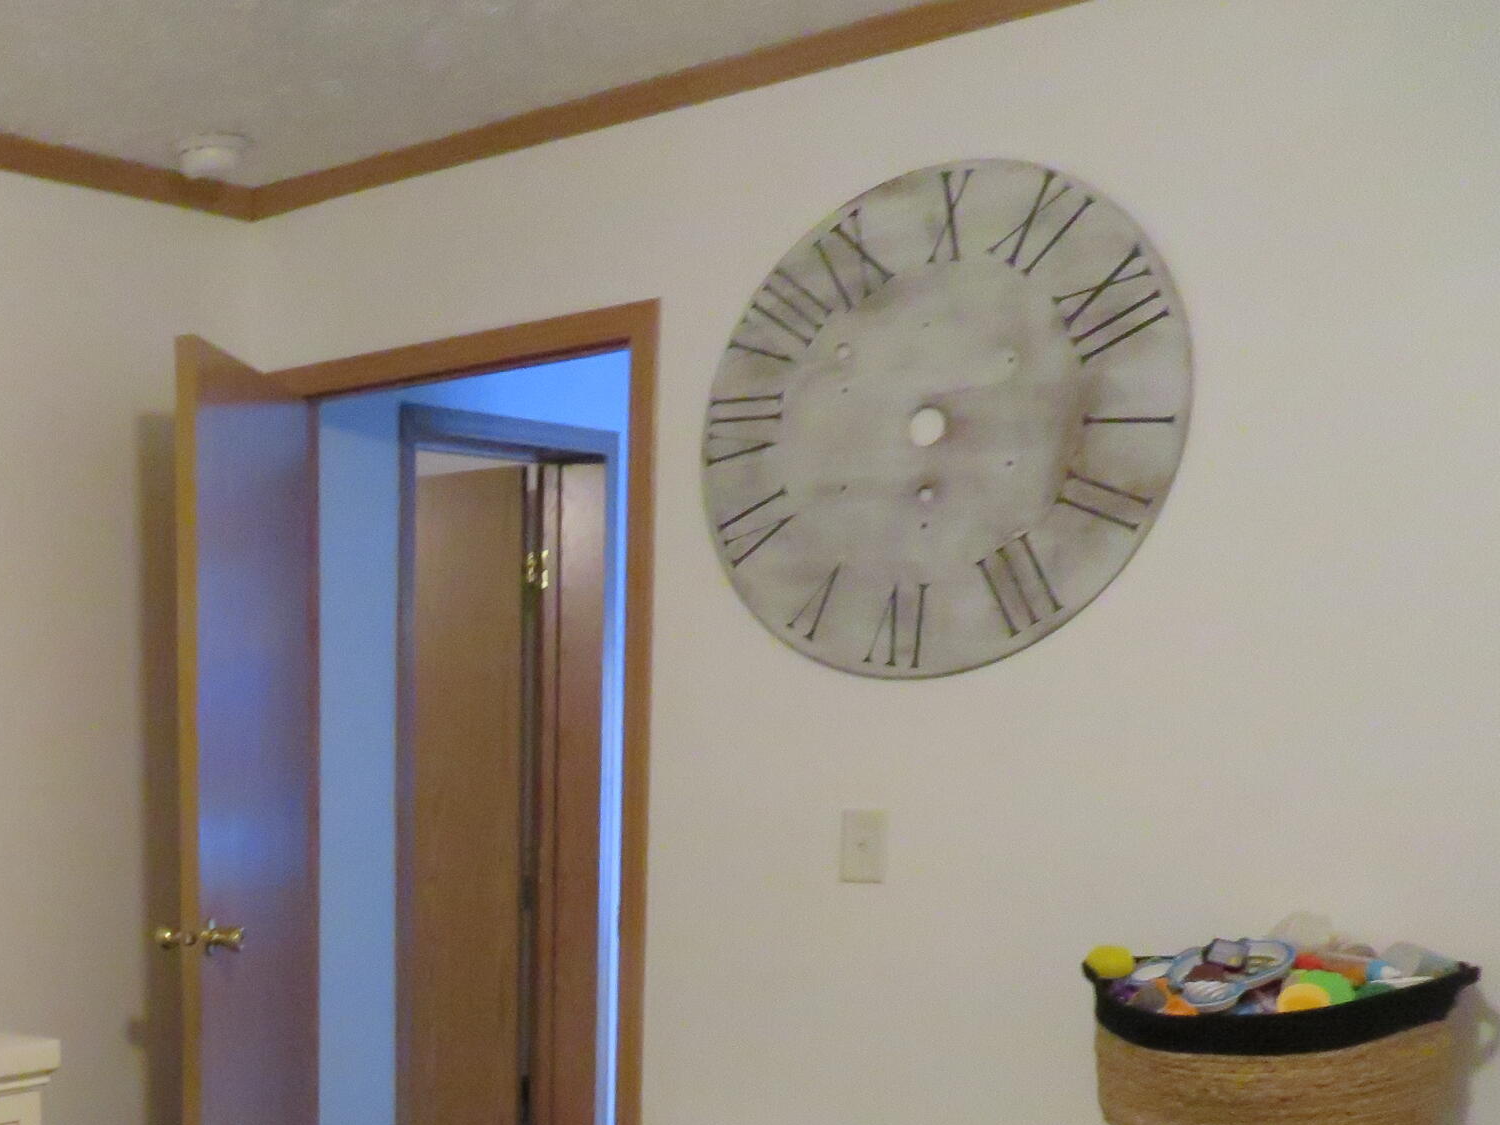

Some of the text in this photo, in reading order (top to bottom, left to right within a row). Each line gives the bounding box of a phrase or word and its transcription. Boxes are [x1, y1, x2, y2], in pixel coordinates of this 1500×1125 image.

[812, 207, 896, 312] IX
[927, 168, 974, 263] X
[985, 169, 1094, 275] XI
[728, 268, 831, 363] VIII
[1050, 241, 1169, 364] XII
[705, 391, 784, 467] VII
[1082, 413, 1175, 426] I
[1055, 469, 1154, 531] II
[787, 562, 841, 640] V
[976, 530, 1064, 638] III
